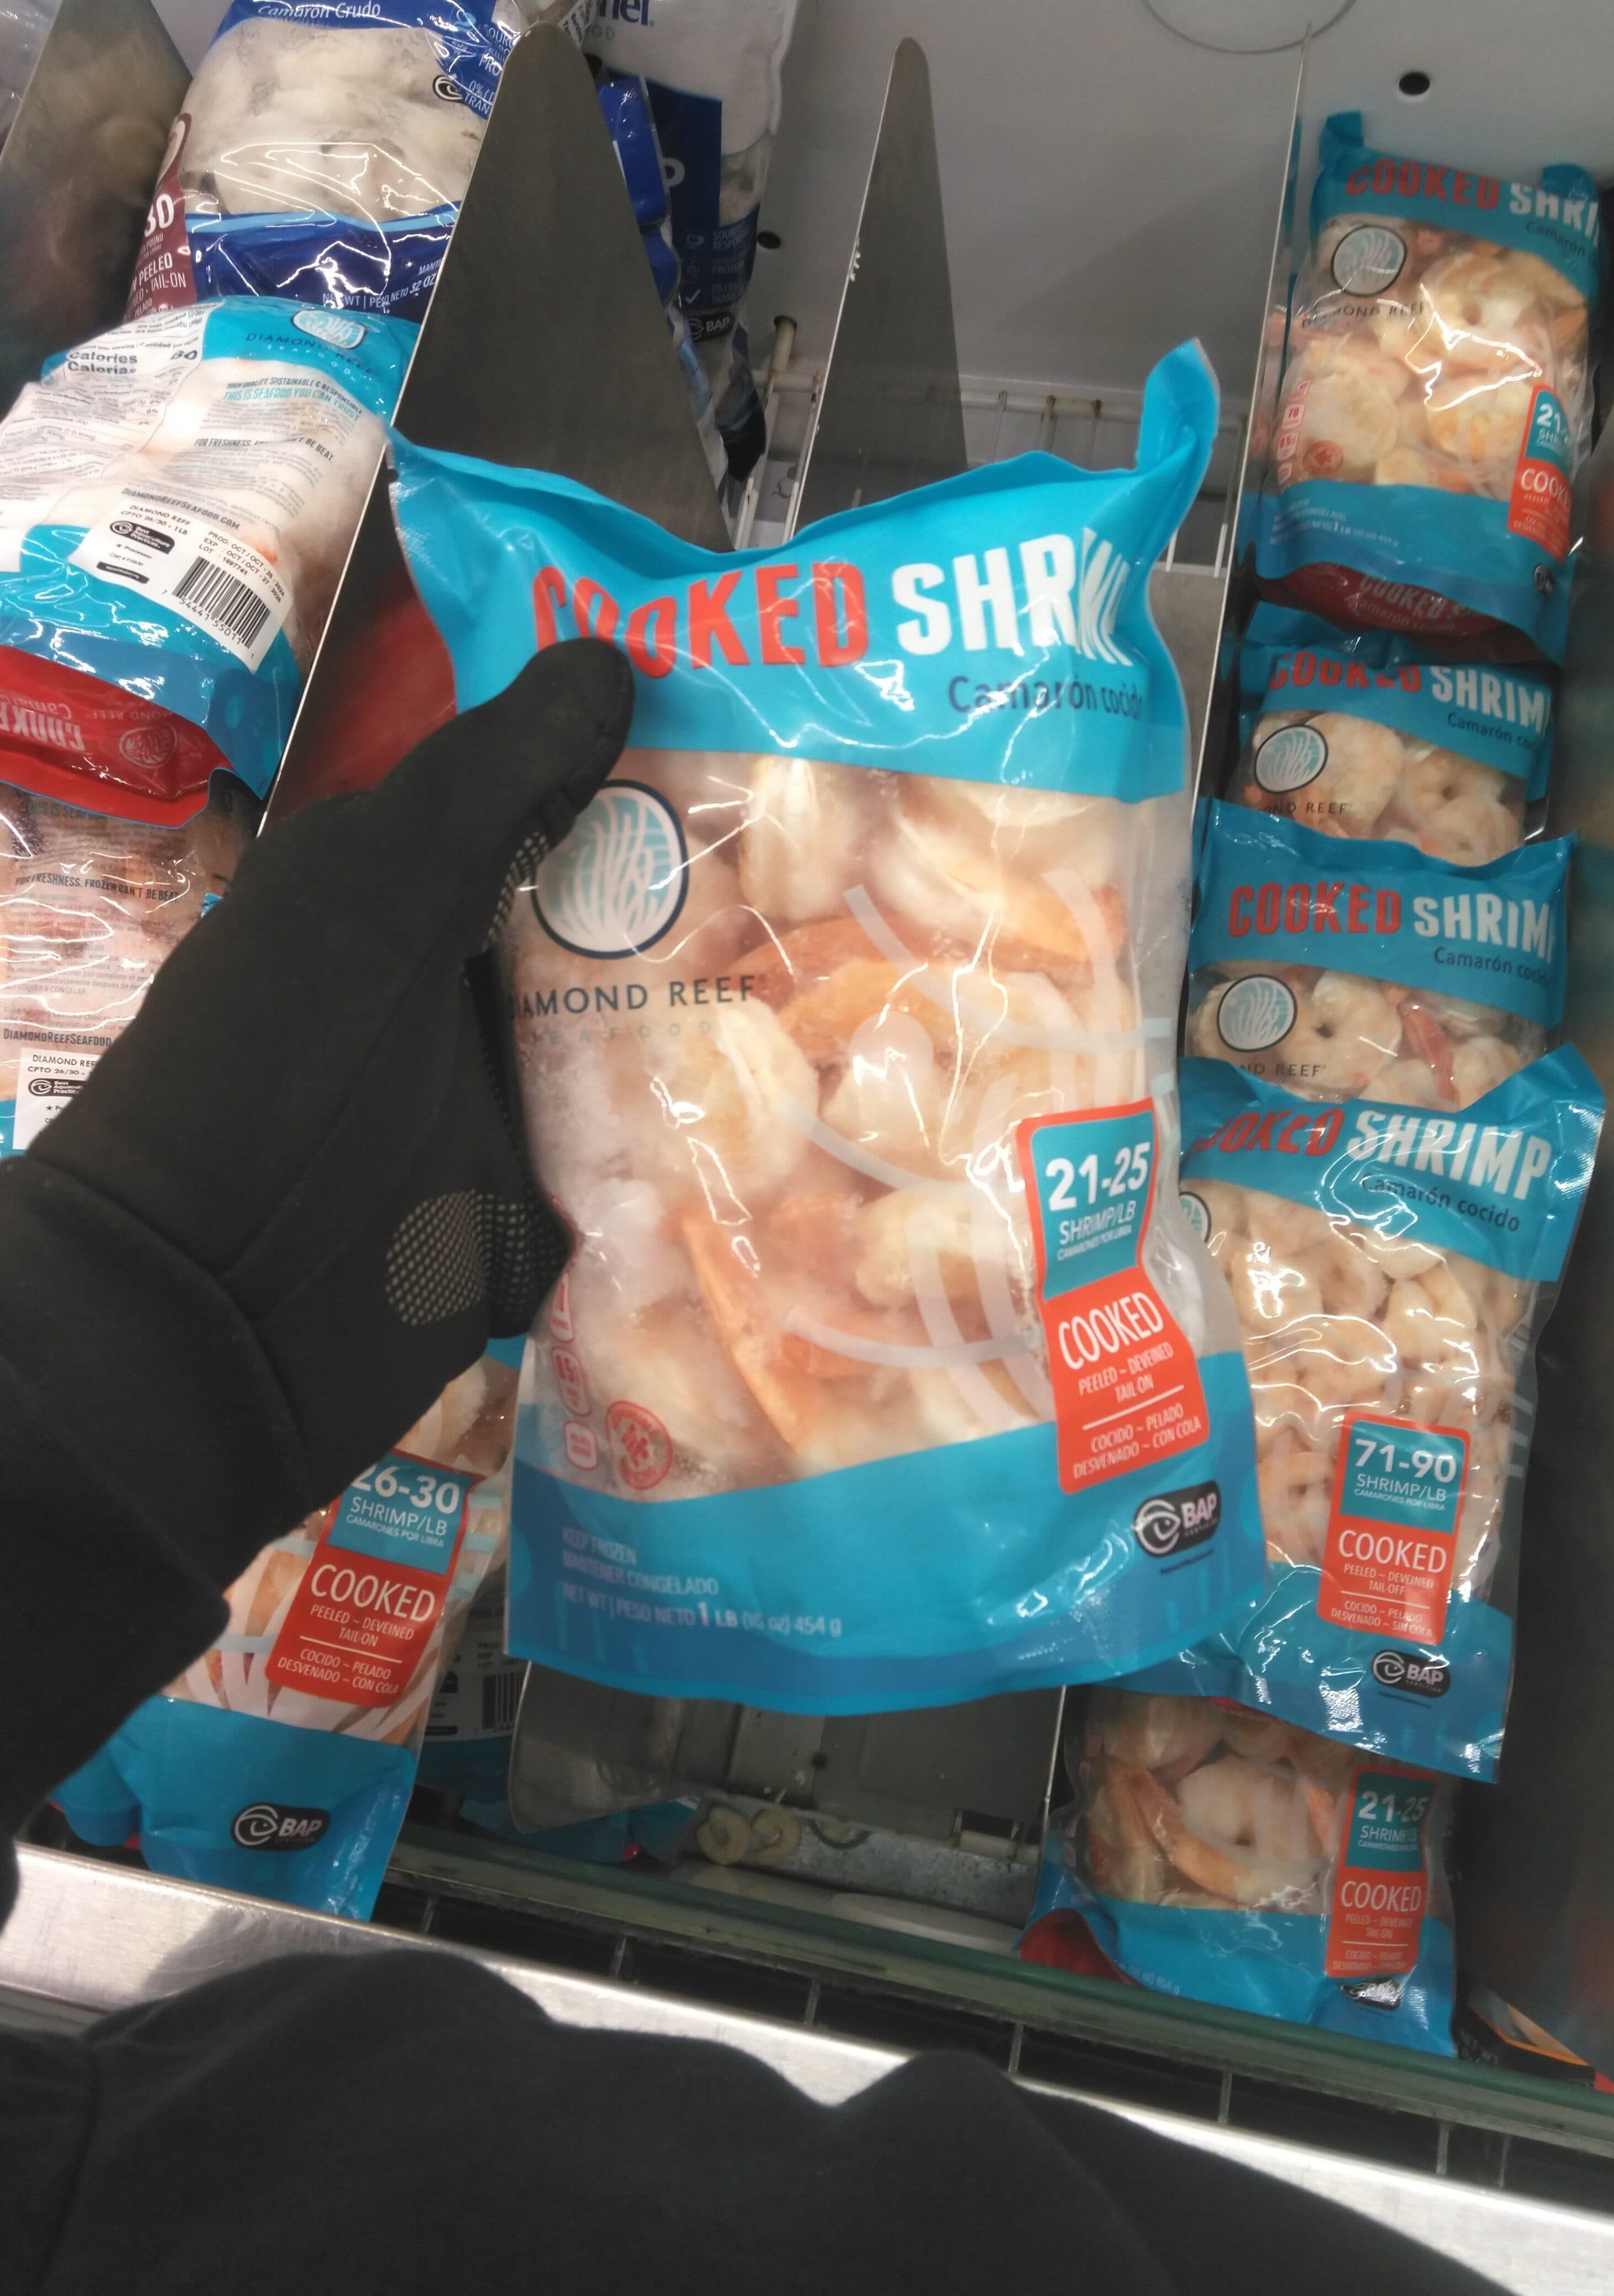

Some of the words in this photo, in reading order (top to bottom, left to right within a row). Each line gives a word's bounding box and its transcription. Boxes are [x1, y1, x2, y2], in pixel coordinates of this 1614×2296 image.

[335, 1, 381, 18] Crudo
[1345, 157, 1501, 211] COOKED
[139, 252, 173, 286] PEELED
[151, 272, 187, 292] TAIL-ON
[391, 287, 409, 304] NETO
[409, 280, 422, 294] 32
[423, 273, 437, 288] OZ
[68, 350, 138, 365] Calories
[130, 504, 170, 519] DIAMOND
[199, 544, 214, 554] LOT
[203, 538, 219, 547] EXP
[227, 550, 241, 563] OCT
[246, 562, 259, 575] OCT
[231, 543, 247, 556] OCT
[250, 555, 264, 568] OCT
[212, 620, 243, 645] 55011
[1306, 801, 1348, 815] REEF
[146, 888, 158, 901] BE
[1228, 881, 1403, 938] COOKED
[1434, 945, 1513, 975] Camarón
[522, 984, 648, 1017] AMOND
[669, 975, 756, 1007] REEF
[32, 1054, 77, 1066] DIAMOND
[1275, 1062, 1321, 1078] REEF
[1346, 1109, 1553, 1200] SHRIMP
[1046, 1141, 1151, 1212] 21-25
[1361, 1171, 1452, 1210] Camarón
[1457, 1198, 1521, 1233] cocido
[1059, 1200, 1137, 1245] SHRIMP/LB
[1058, 1292, 1164, 1370] COOKED
[1078, 1366, 1118, 1396] PEELED
[1115, 1380, 1137, 1403] TAIL
[1137, 1373, 1154, 1394] ON
[1090, 1424, 1134, 1454] COCIDO
[1146, 1402, 1184, 1431] PELADO
[1152, 1428, 1176, 1449] CON
[1175, 1415, 1202, 1440] COLA
[1354, 1438, 1458, 1484] 71-90
[350, 1464, 460, 1514] 26-30
[1356, 1473, 1447, 1503] SHRIMP/LB
[346, 1514, 399, 1537] CAMARONES
[350, 1496, 448, 1536] SHRIMP/LB
[1180, 1492, 1218, 1529] BAP
[1339, 1529, 1447, 1574] COOKED
[1344, 1563, 1377, 1578] PEELED
[1388, 1571, 1434, 1590] DEVEINED
[1368, 1580, 1386, 1593] TAIL
[1387, 1582, 1405, 1596] OFF
[310, 1564, 435, 1623] COOKED
[1344, 1600, 1377, 1615] COCIDO
[310, 1603, 350, 1625] PEELED
[362, 1617, 414, 1641] DEVEINED
[697, 1601, 710, 1627] 1
[714, 1608, 739, 1628] LB
[339, 1627, 359, 1644] TAIL
[360, 1633, 380, 1648] ON
[278, 1657, 340, 1683] DESVENADO
[352, 1676, 375, 1691] CON
[300, 1648, 341, 1668] COCIDO
[351, 1661, 391, 1680] PELADO
[1407, 1663, 1445, 1686] BAP
[1357, 1790, 1429, 1823] 21-25
[278, 1817, 323, 1837] BAP
[1341, 1880, 1422, 1913] COOKED
